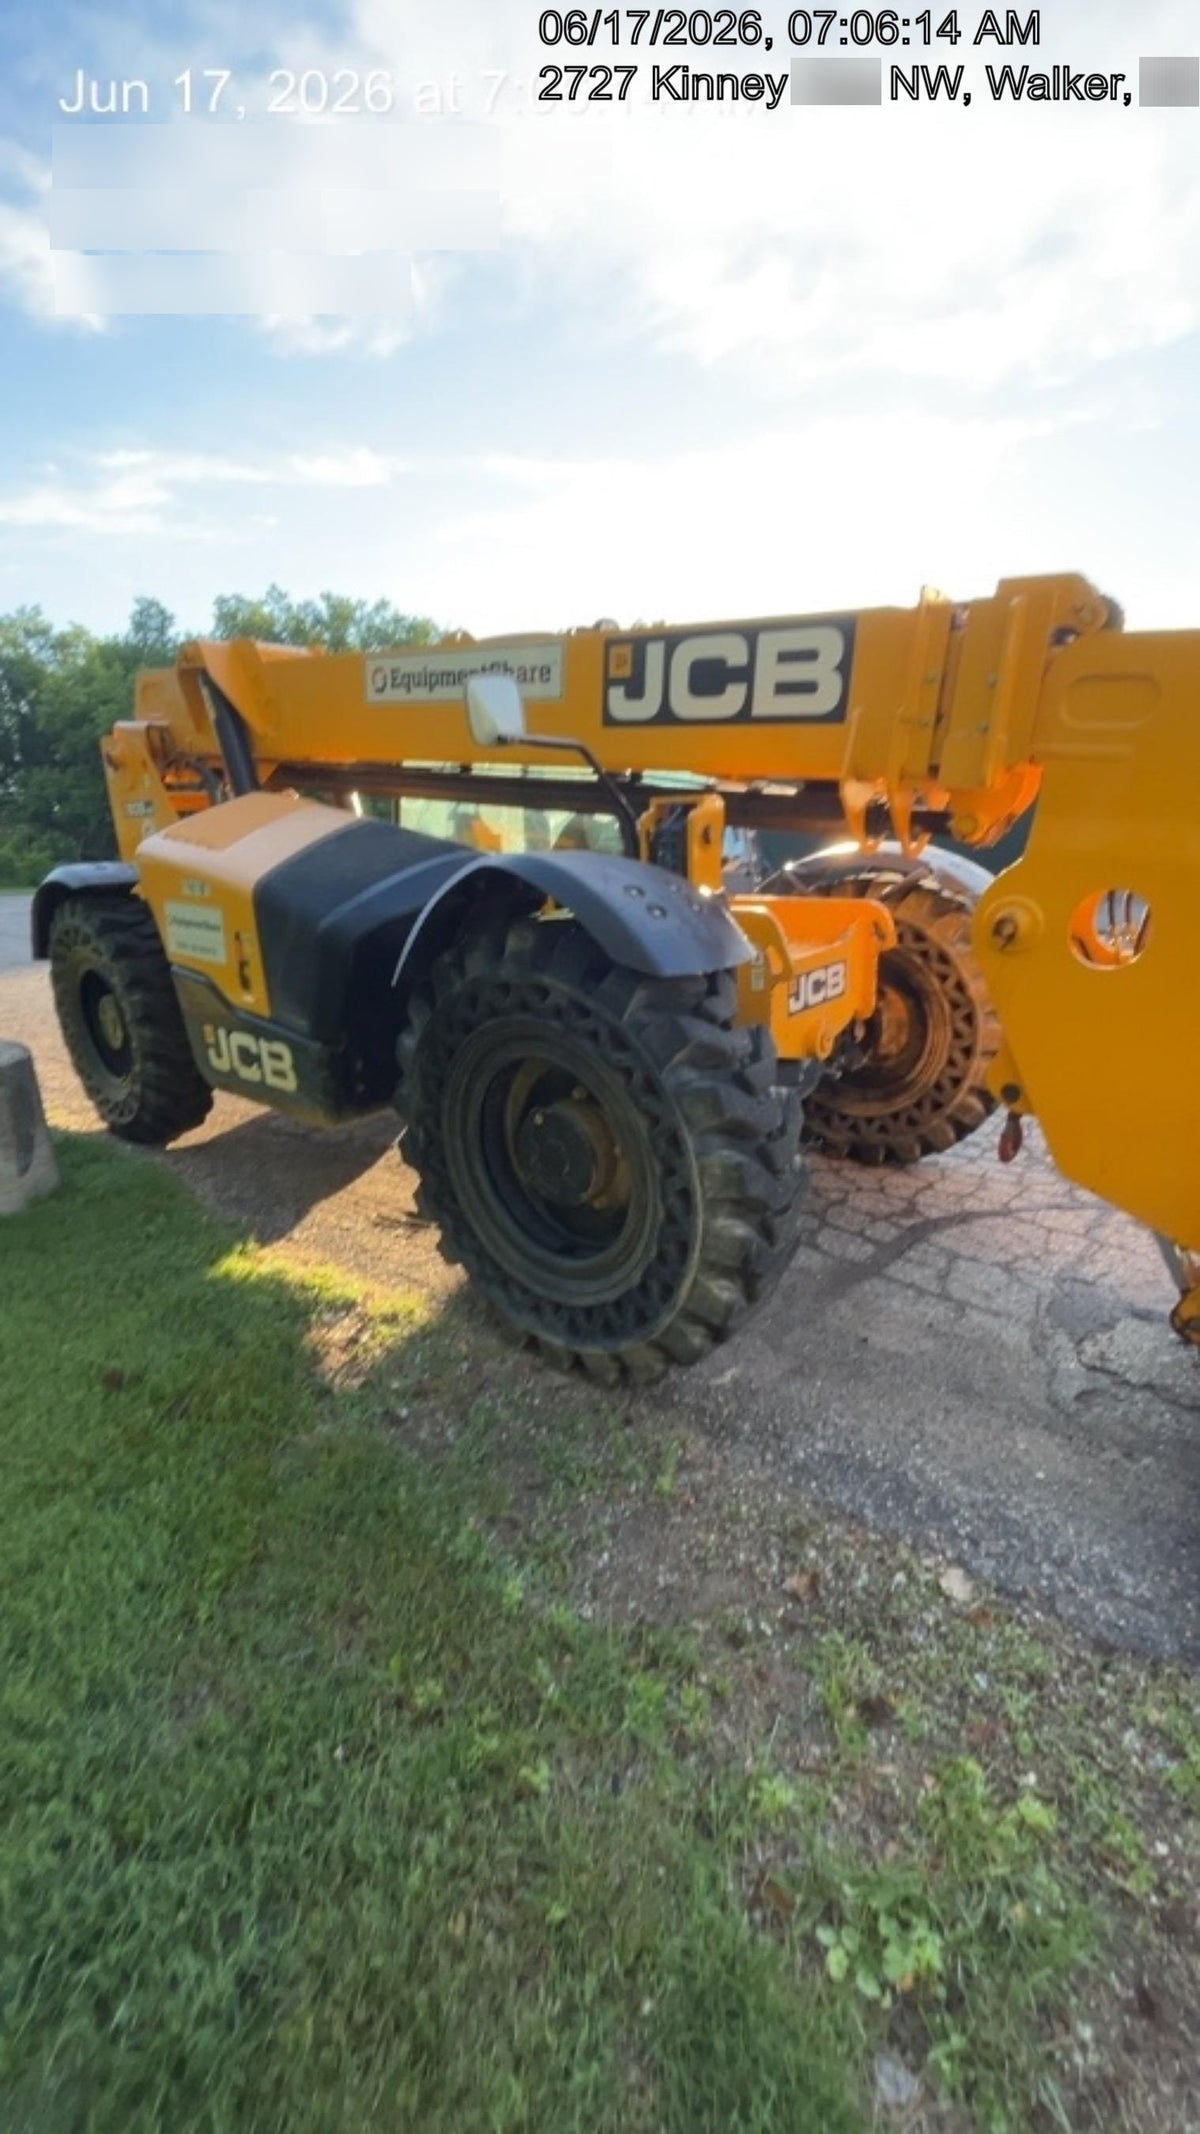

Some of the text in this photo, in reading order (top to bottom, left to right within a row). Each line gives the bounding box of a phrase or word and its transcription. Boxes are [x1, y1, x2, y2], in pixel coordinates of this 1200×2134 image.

[606, 625, 845, 722] JCB
[788, 962, 846, 1014] JCB
[206, 1025, 297, 1093] JCB
